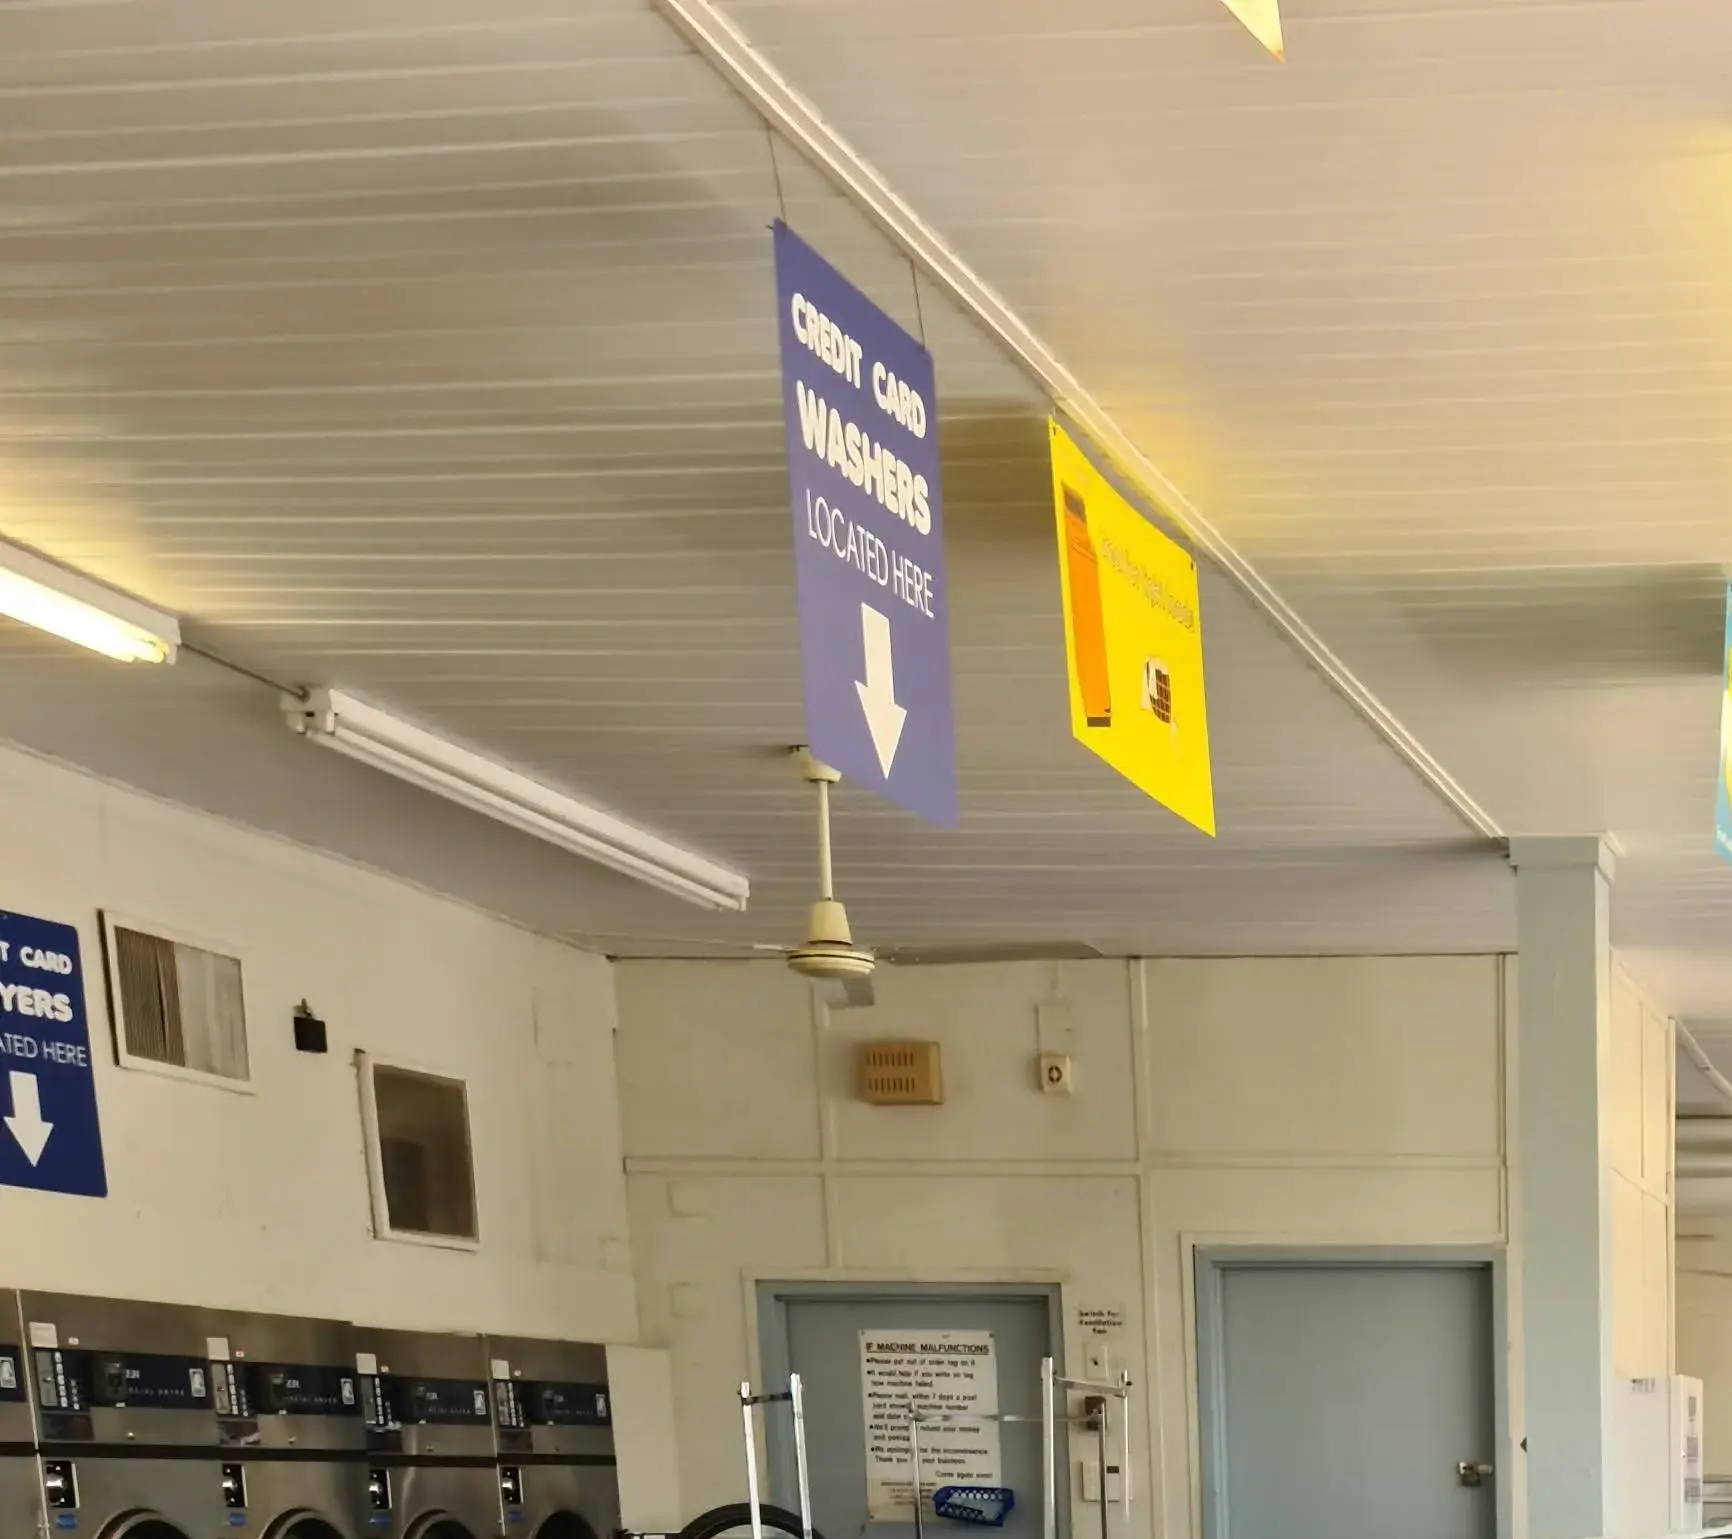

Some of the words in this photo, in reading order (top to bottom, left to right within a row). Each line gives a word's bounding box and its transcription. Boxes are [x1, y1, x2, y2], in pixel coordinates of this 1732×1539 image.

[792, 293, 862, 389] CREDIT
[873, 362, 926, 438] CARD
[797, 379, 931, 535] WASHERS
[806, 487, 888, 586] LOCATED
[892, 550, 935, 619] HERE
[20, 946, 73, 975] CARD
[42, 1040, 88, 1068] HERE
[877, 1343, 917, 1352] MACHINE
[920, 1343, 990, 1354] MALFUNCTIONS
